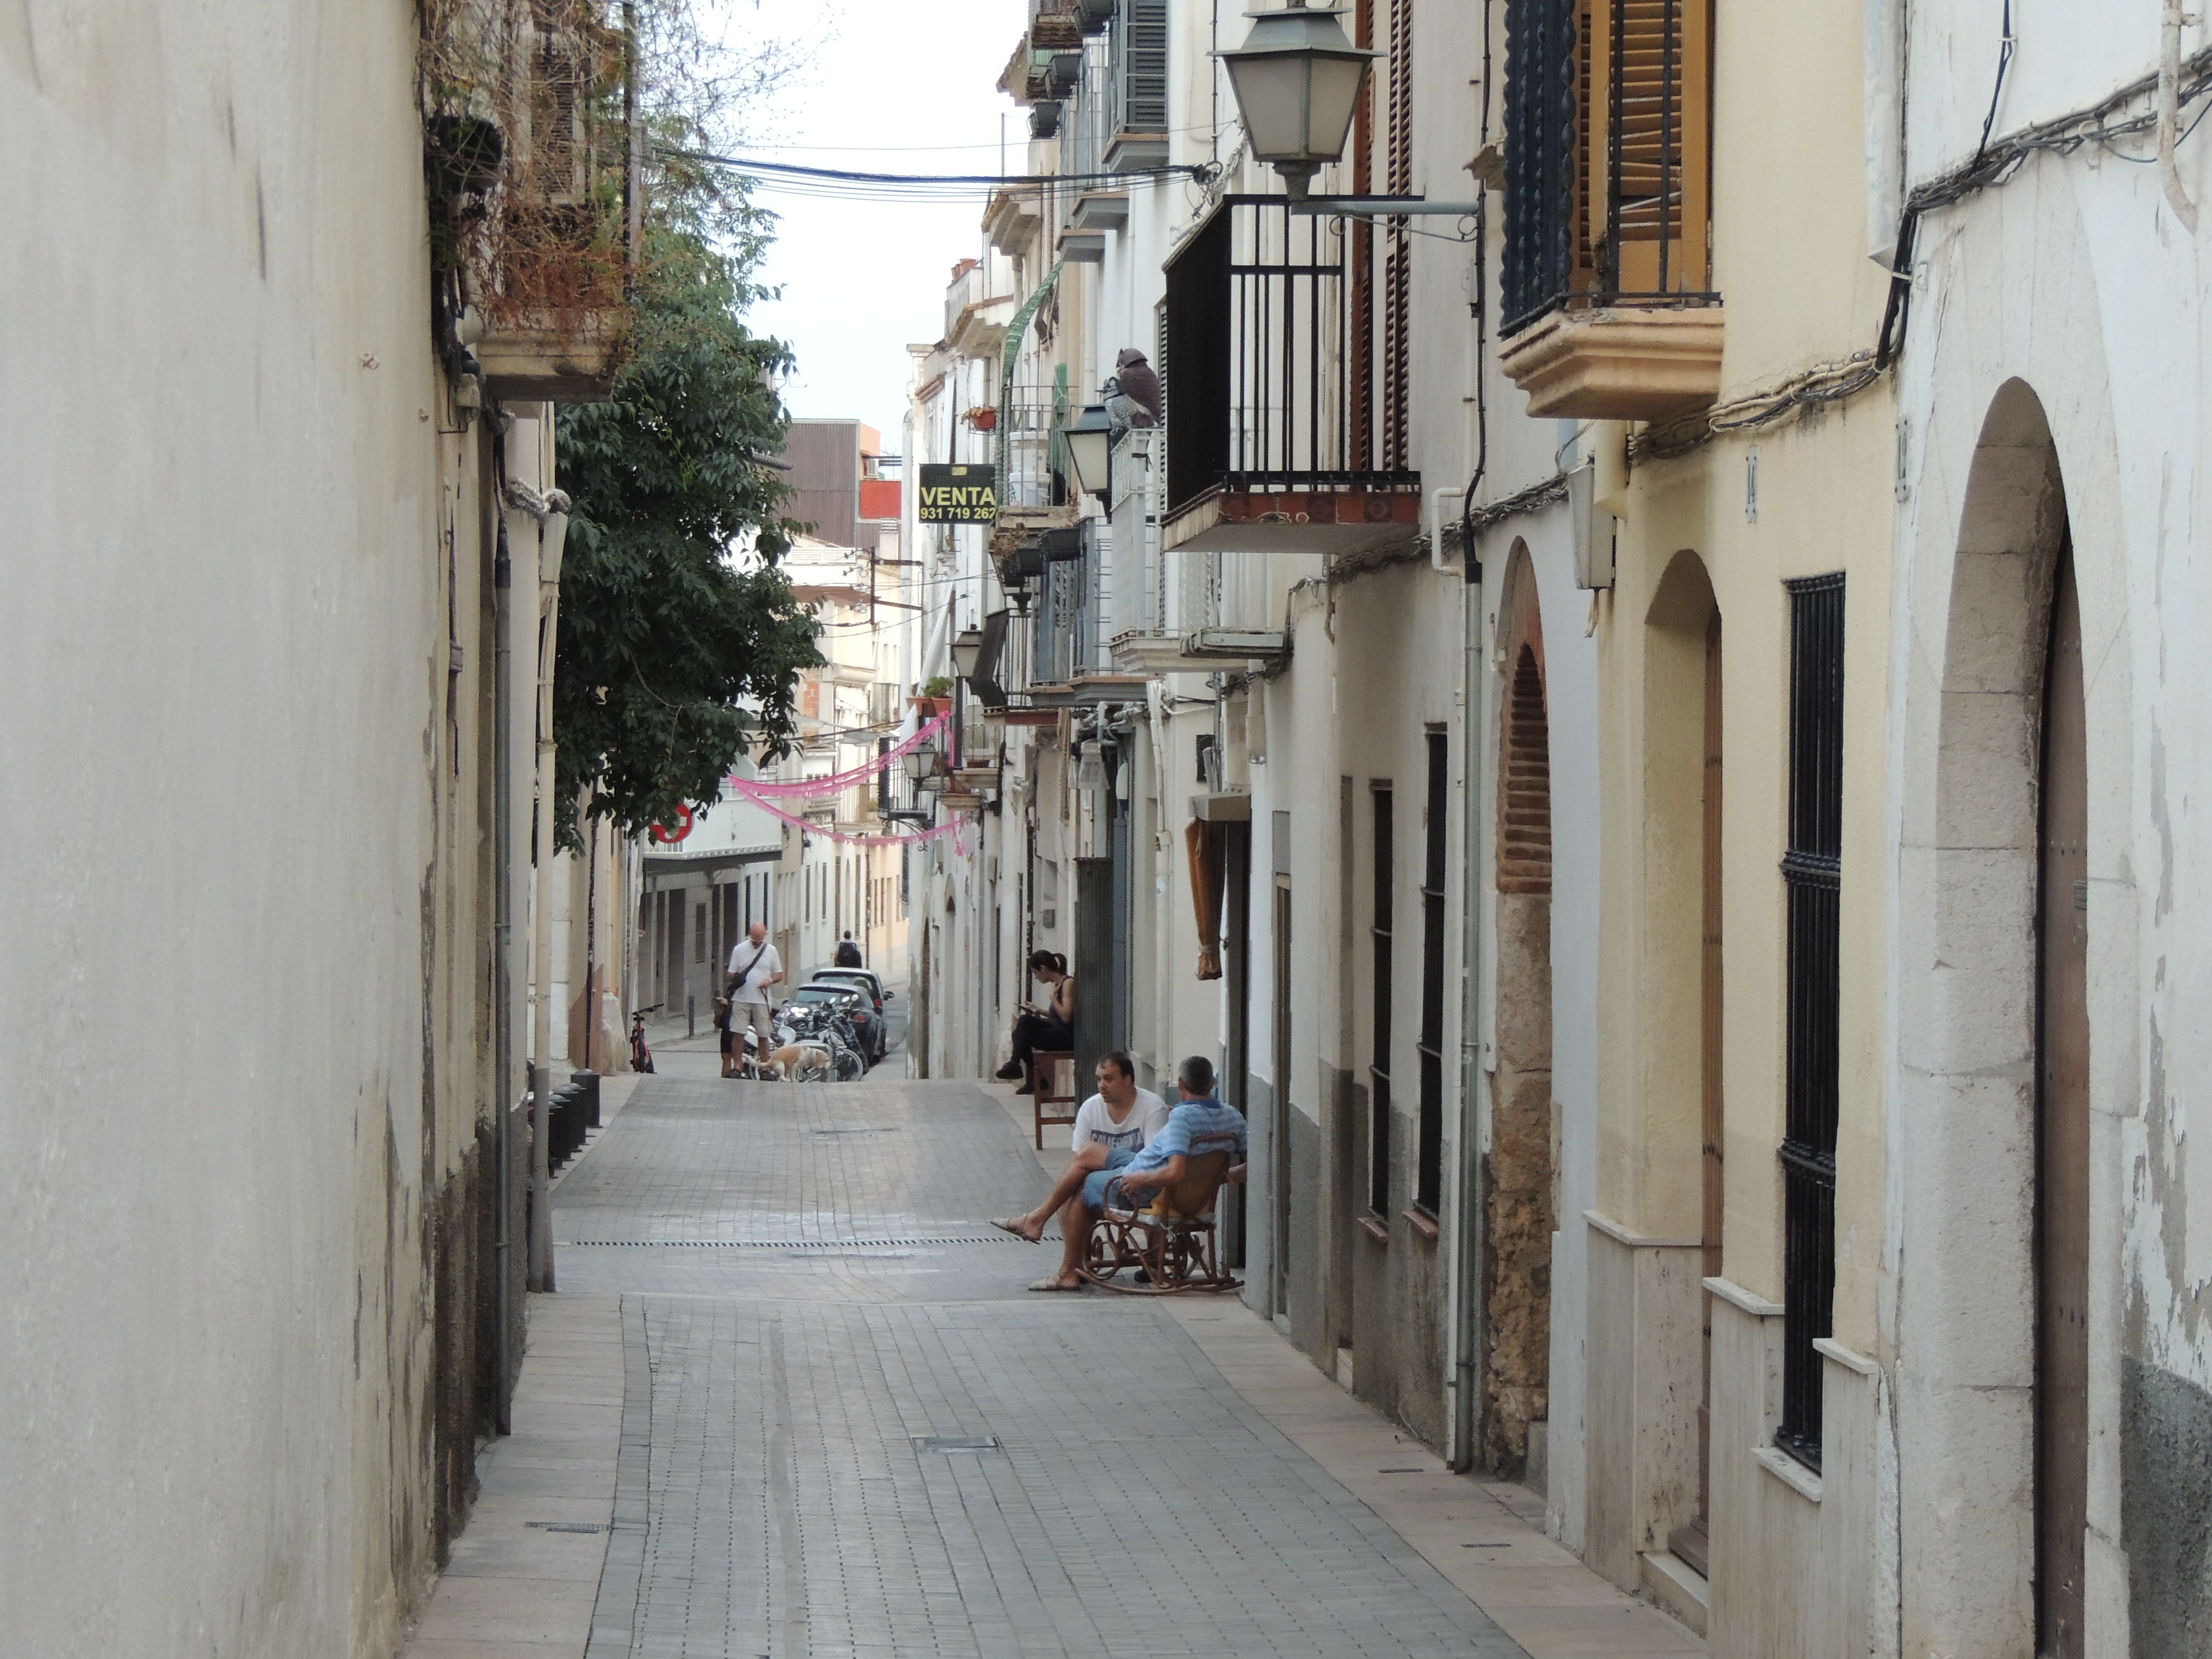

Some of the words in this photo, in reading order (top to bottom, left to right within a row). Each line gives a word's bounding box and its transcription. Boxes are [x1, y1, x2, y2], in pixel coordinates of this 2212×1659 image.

[921, 487, 996, 505] VENTA
[920, 507, 942, 519] 931
[947, 507, 970, 519] 719
[974, 507, 996, 519] 262
